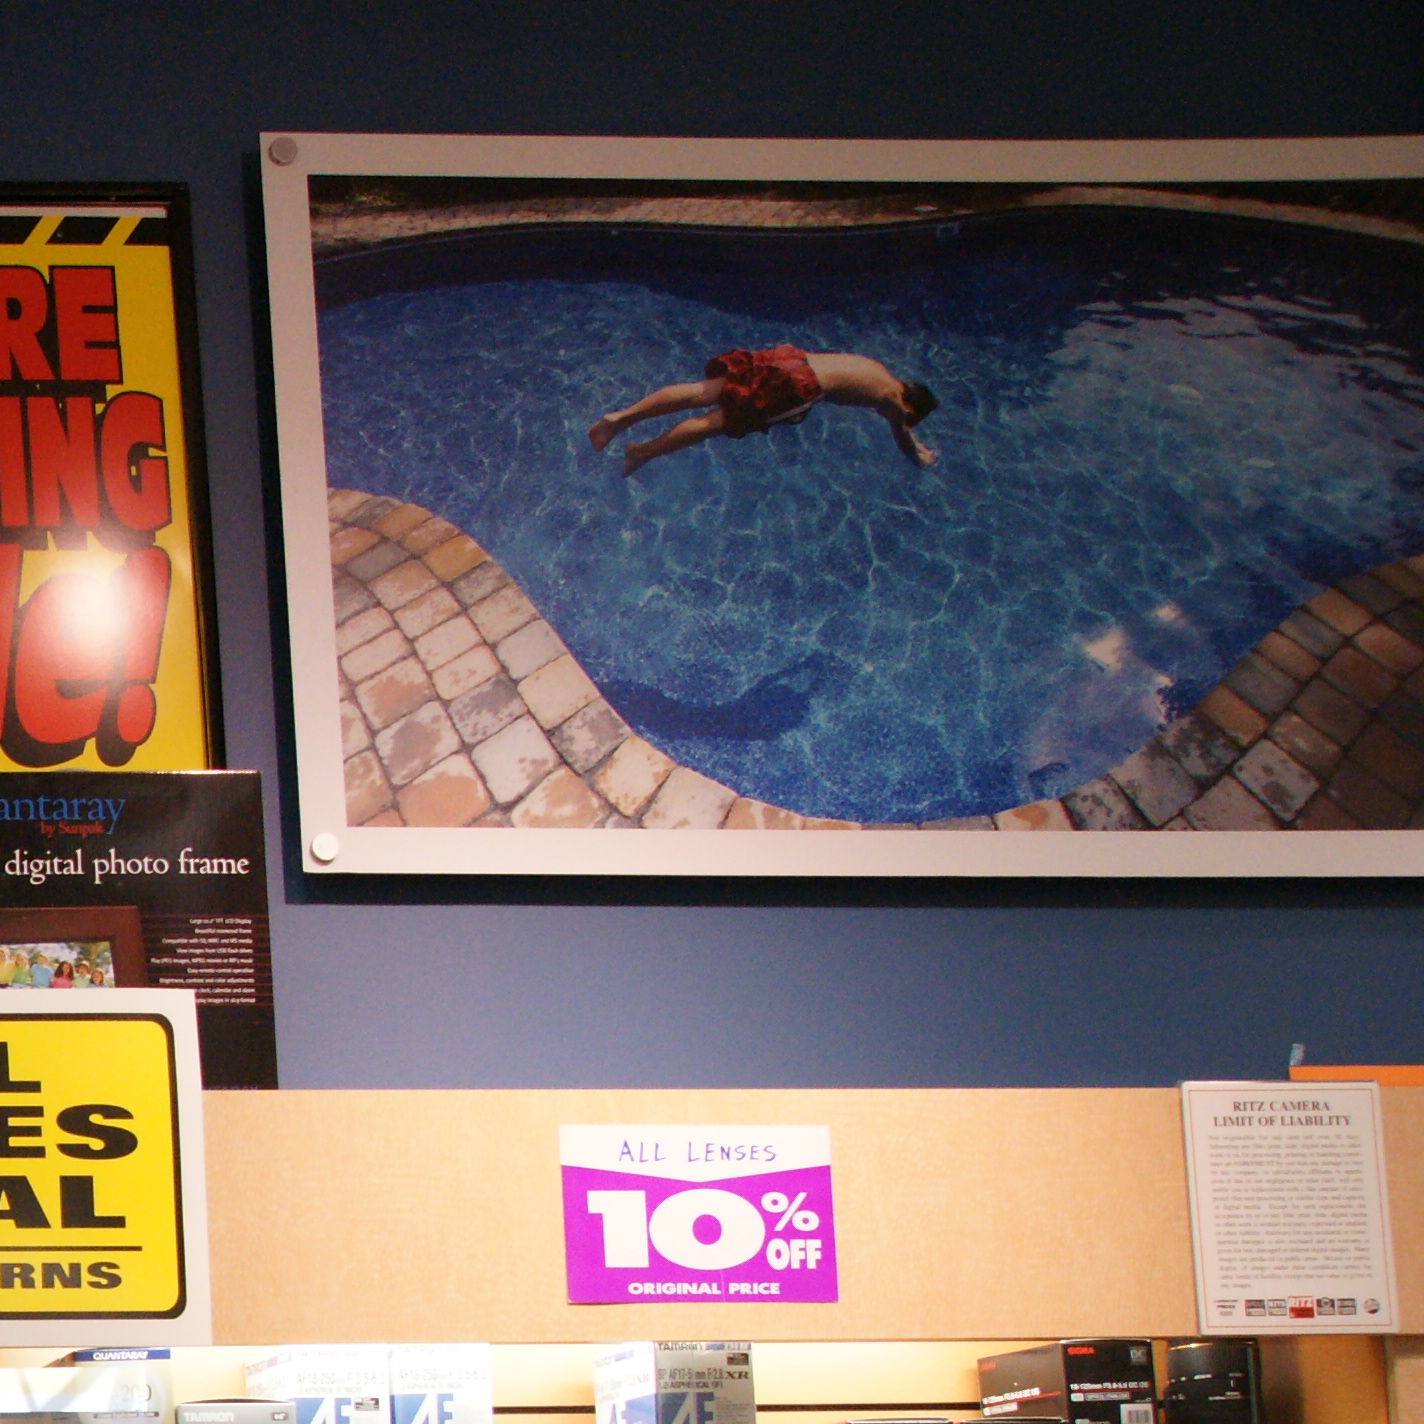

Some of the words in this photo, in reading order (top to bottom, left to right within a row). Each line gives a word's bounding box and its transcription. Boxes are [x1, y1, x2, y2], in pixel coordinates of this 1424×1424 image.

[4, 848, 84, 885] digital
[93, 848, 169, 885] photo
[178, 848, 250, 876] frame
[1232, 1100, 1265, 1112] RITZ
[1269, 1101, 1330, 1112] CAMERA
[1213, 1116, 1253, 1127] LIMIT
[1258, 1116, 1276, 1127] OF
[1280, 1115, 1351, 1127] LIABILITY
[618, 1140, 666, 1163] ALL
[688, 1141, 777, 1163] LENSES
[766, 1238, 822, 1270] OFF
[627, 1283, 721, 1295] ORIGINAL
[729, 1282, 780, 1295] PRICE
[93, 1351, 148, 1360] QUANTARAY
